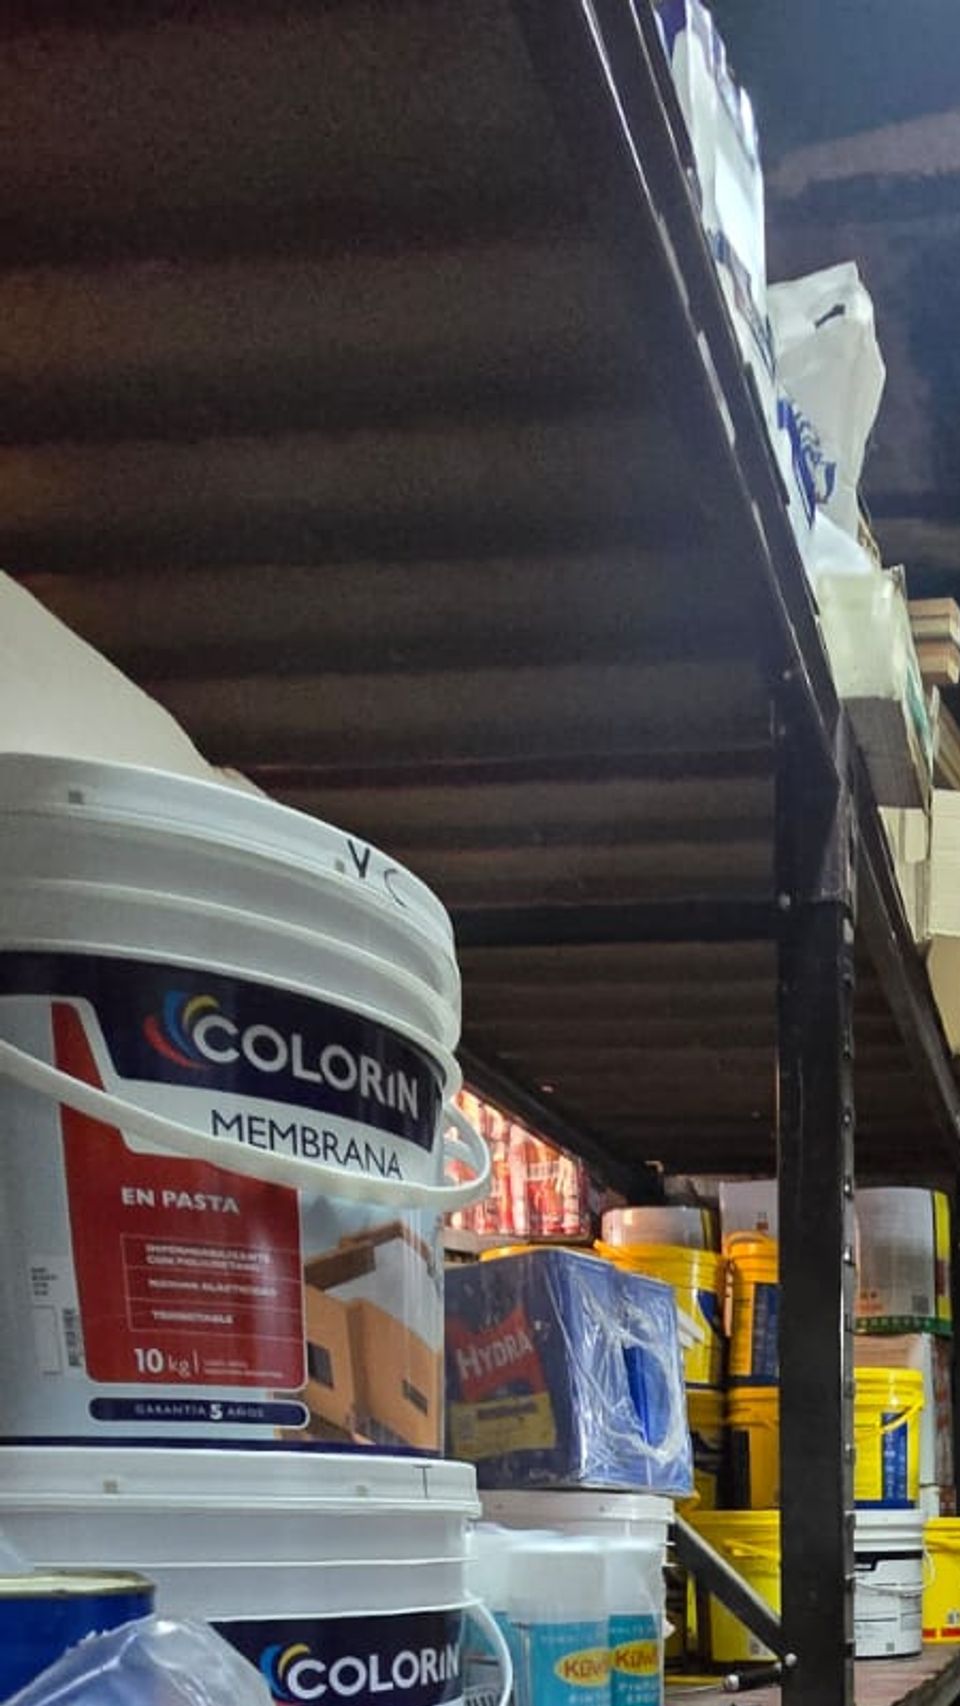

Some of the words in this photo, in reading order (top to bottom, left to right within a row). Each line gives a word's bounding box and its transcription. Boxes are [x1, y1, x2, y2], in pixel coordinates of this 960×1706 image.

[192, 1014, 420, 1121] COLORIN
[211, 1109, 403, 1181] MEMBRANA
[121, 1186, 155, 1208] EN
[162, 1189, 240, 1215] PASTA
[133, 1348, 164, 1374] 10
[168, 1354, 190, 1378] kg
[209, 1402, 223, 1420] 5
[287, 1642, 461, 1700] COLORIN
